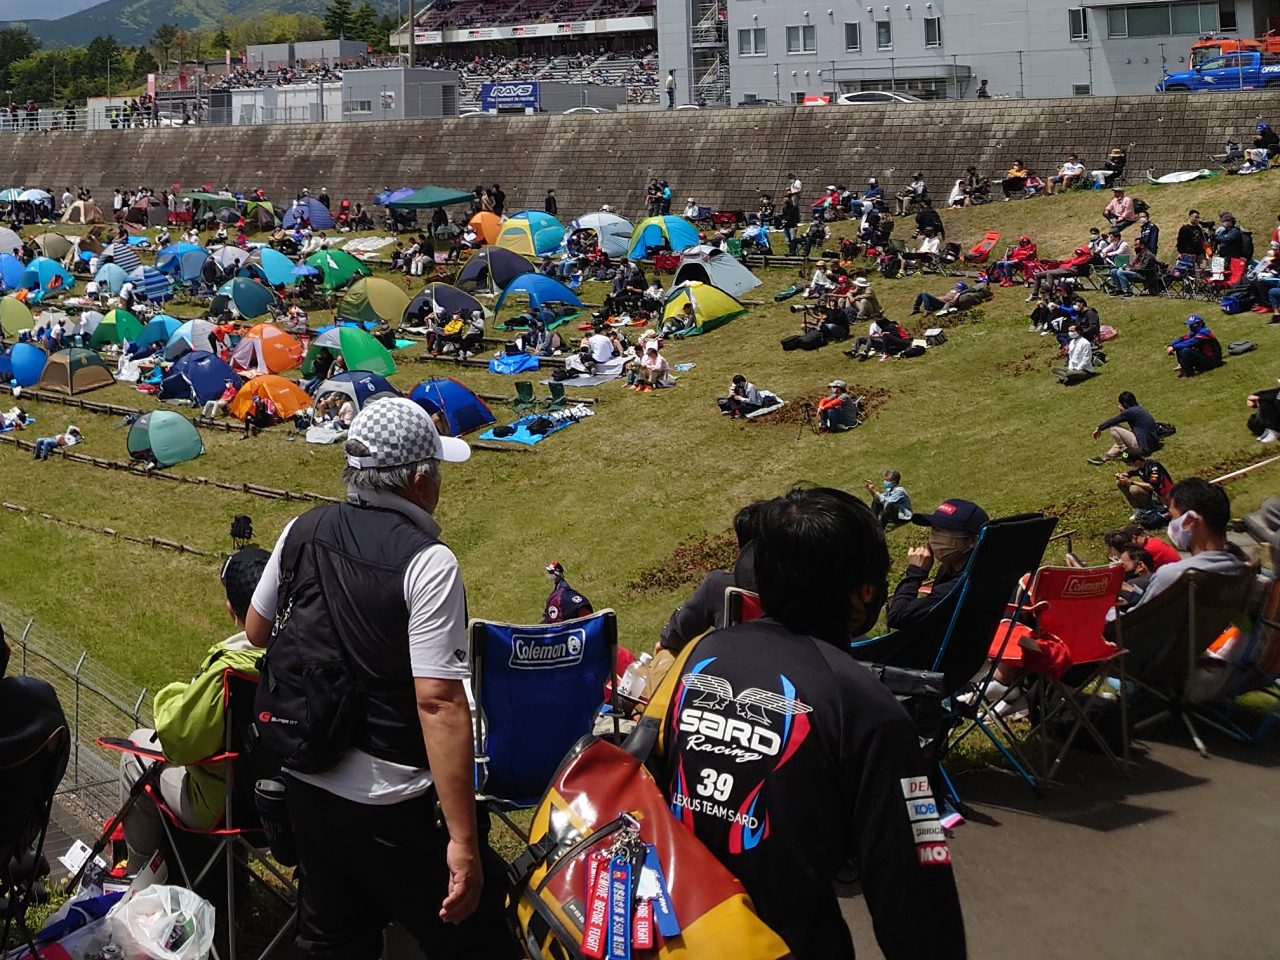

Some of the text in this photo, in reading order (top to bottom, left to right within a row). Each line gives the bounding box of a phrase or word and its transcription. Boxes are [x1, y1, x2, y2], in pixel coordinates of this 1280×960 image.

[490, 85, 533, 96] RAYS
[516, 638, 567, 660] Coleman
[686, 735, 763, 763] Racing
[696, 768, 734, 802] 39
[672, 792, 759, 830] LEXUS TEAM SARD
[586, 870, 610, 953] REMOVE BEFORE FLIGHT
[637, 921, 649, 944] FLIGHT
